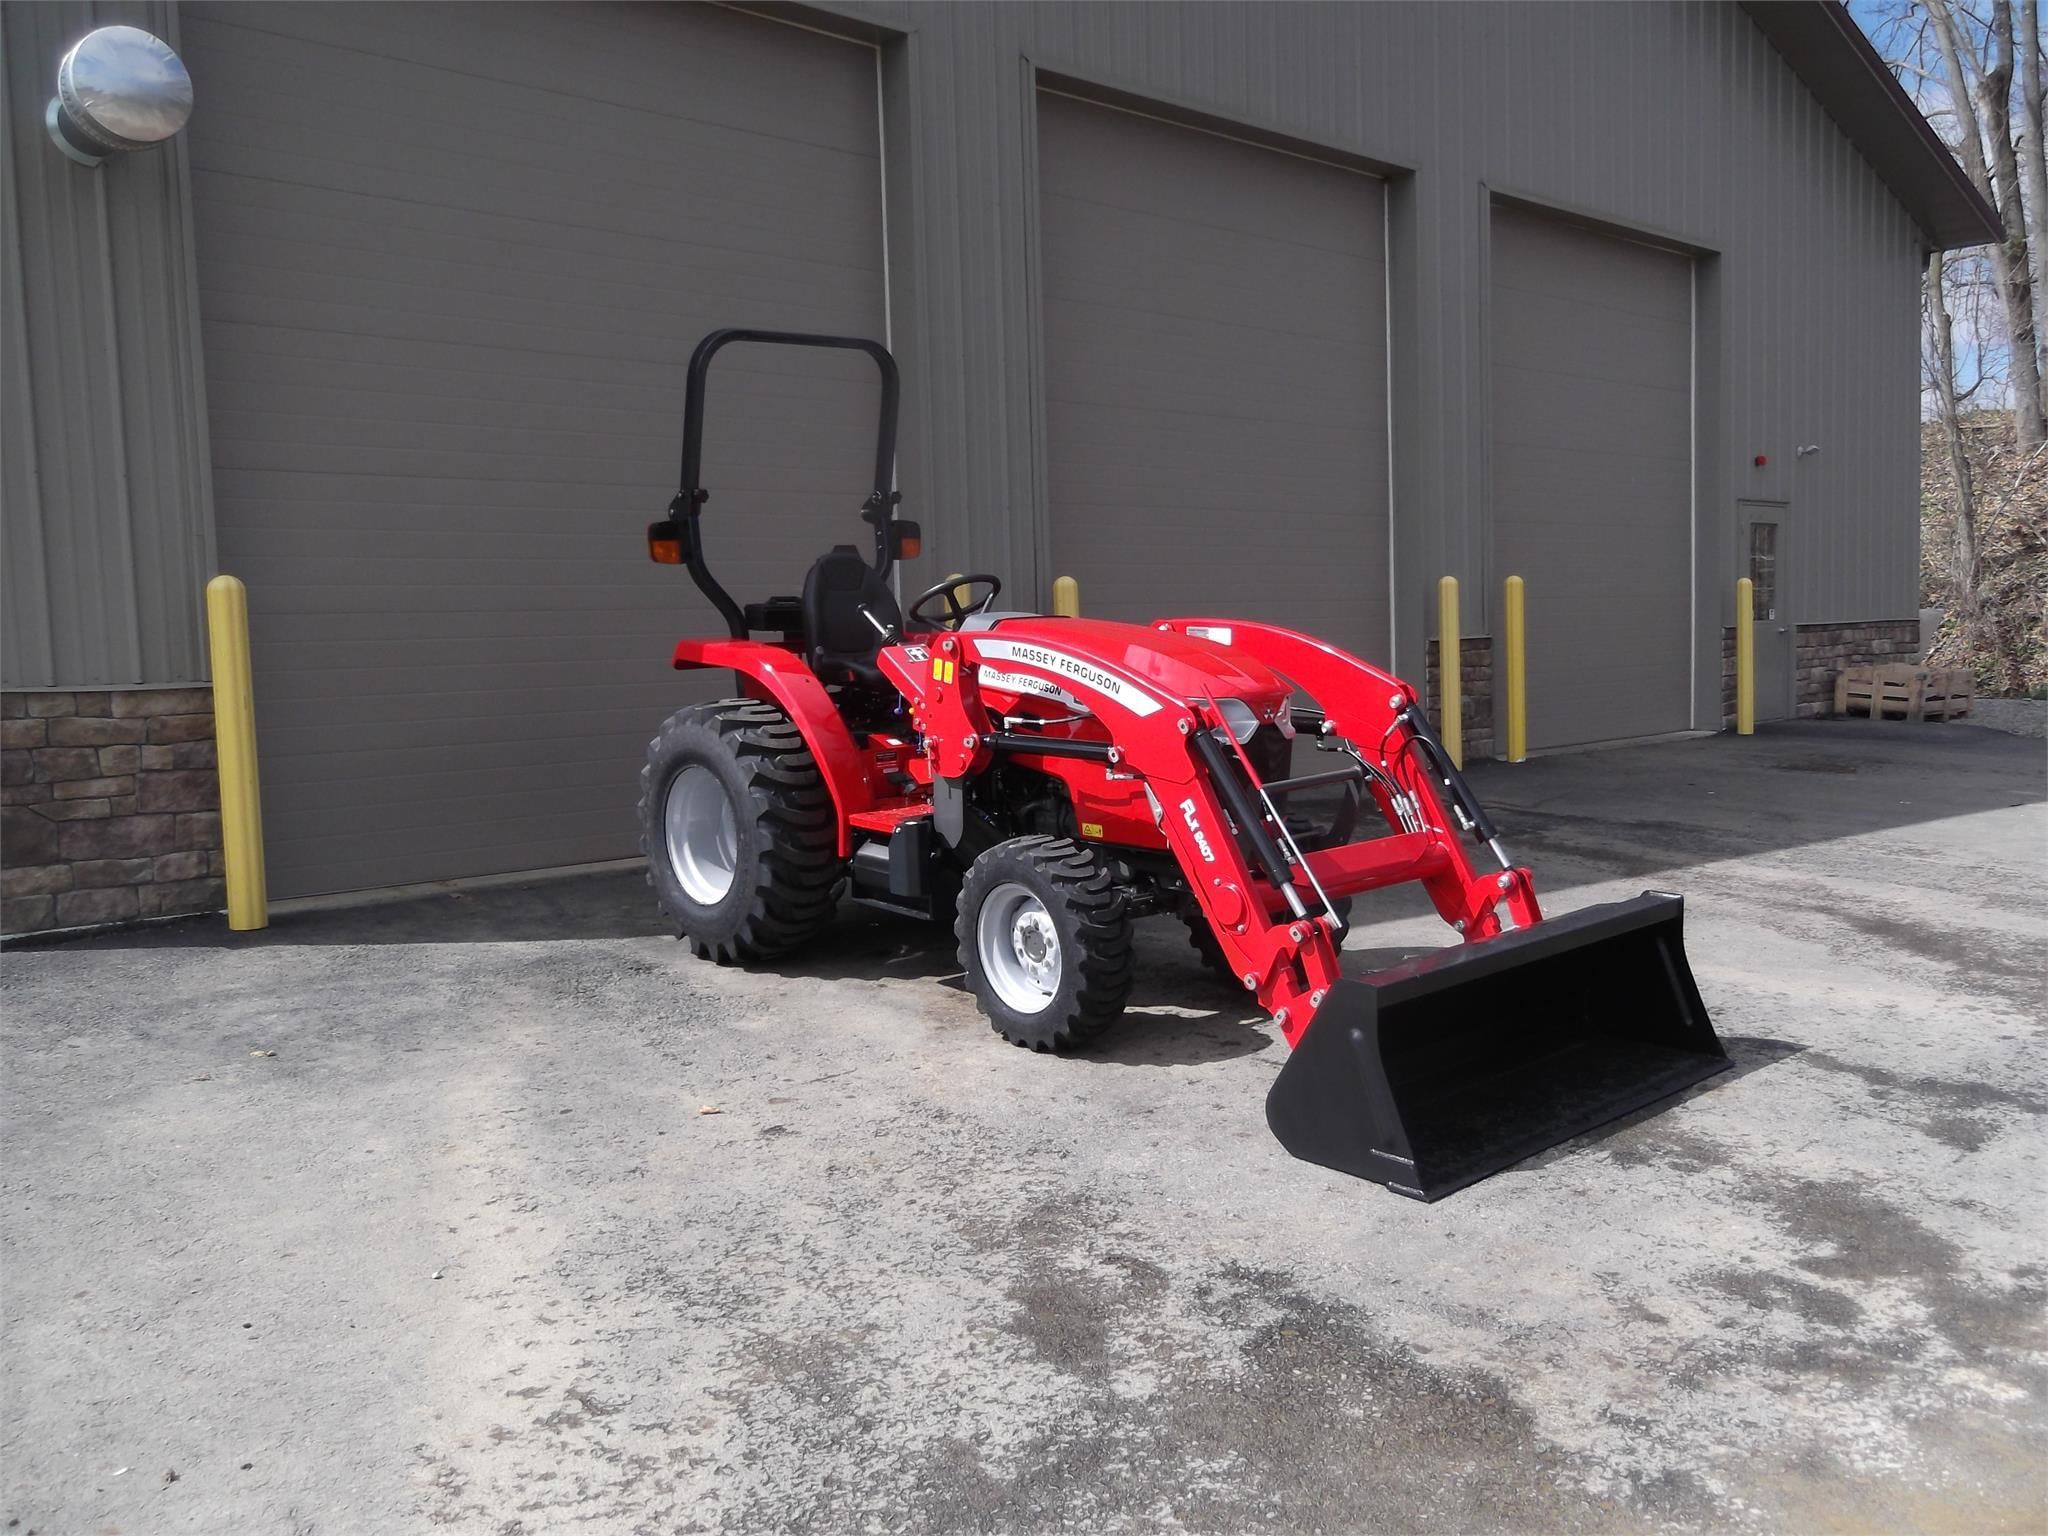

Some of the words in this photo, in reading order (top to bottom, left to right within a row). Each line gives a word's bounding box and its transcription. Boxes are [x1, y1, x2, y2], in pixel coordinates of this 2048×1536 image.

[983, 669, 1016, 684] MASSEY
[1018, 677, 1062, 696] FERGUSON
[1011, 646, 1056, 666] MASSEY
[1060, 658, 1121, 694] FERGUSON
